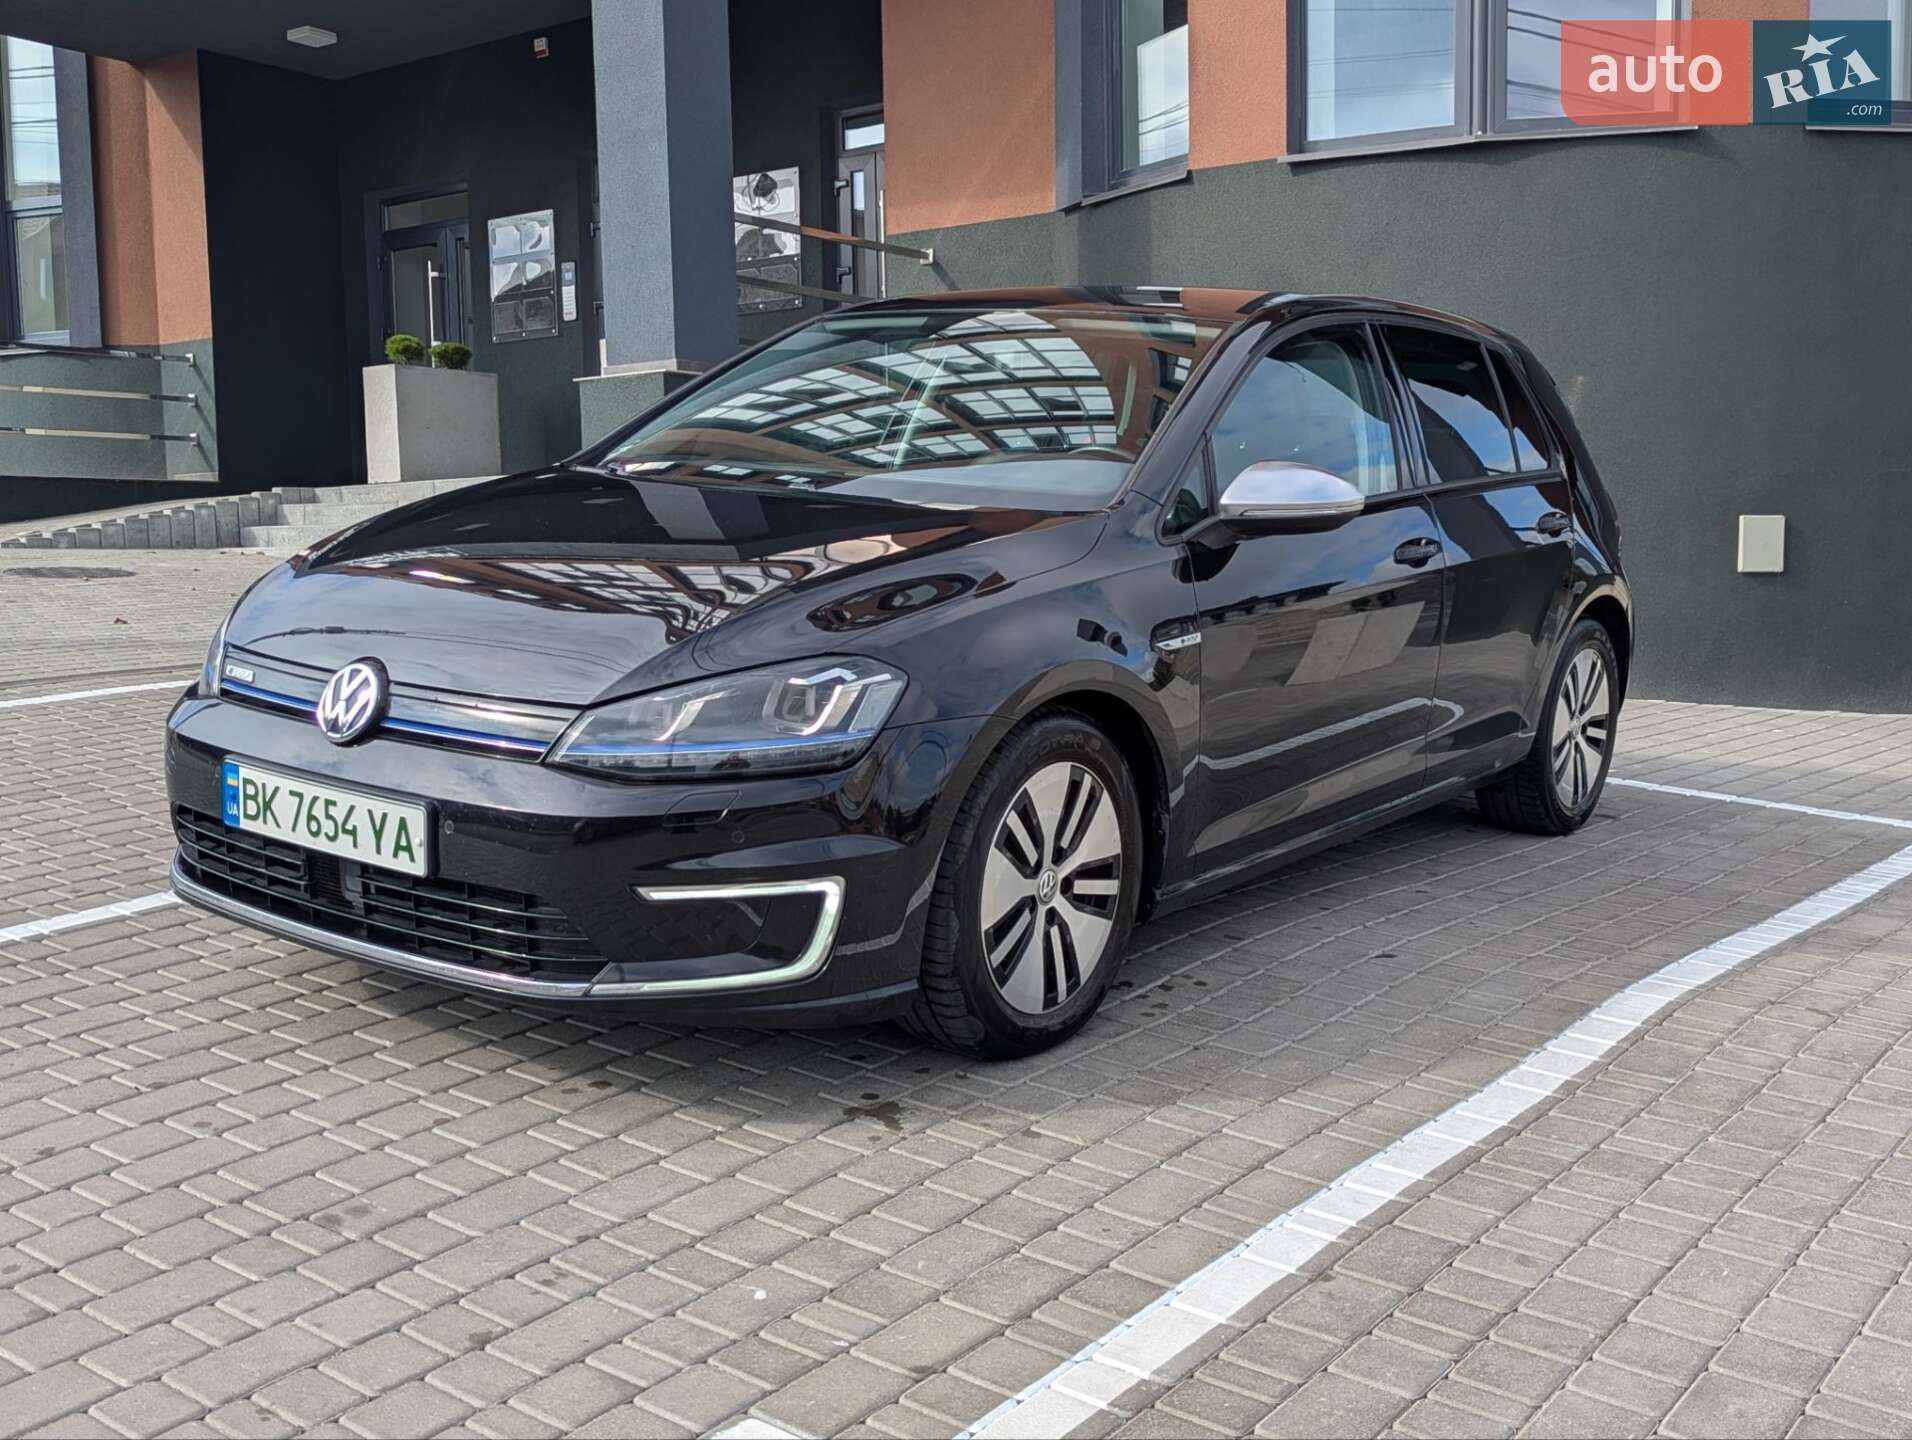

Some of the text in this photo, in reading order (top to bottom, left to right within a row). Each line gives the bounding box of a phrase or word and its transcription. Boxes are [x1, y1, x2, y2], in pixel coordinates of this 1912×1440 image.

[226, 804, 239, 817] UA
[242, 777, 416, 863] BK 7654 YA
